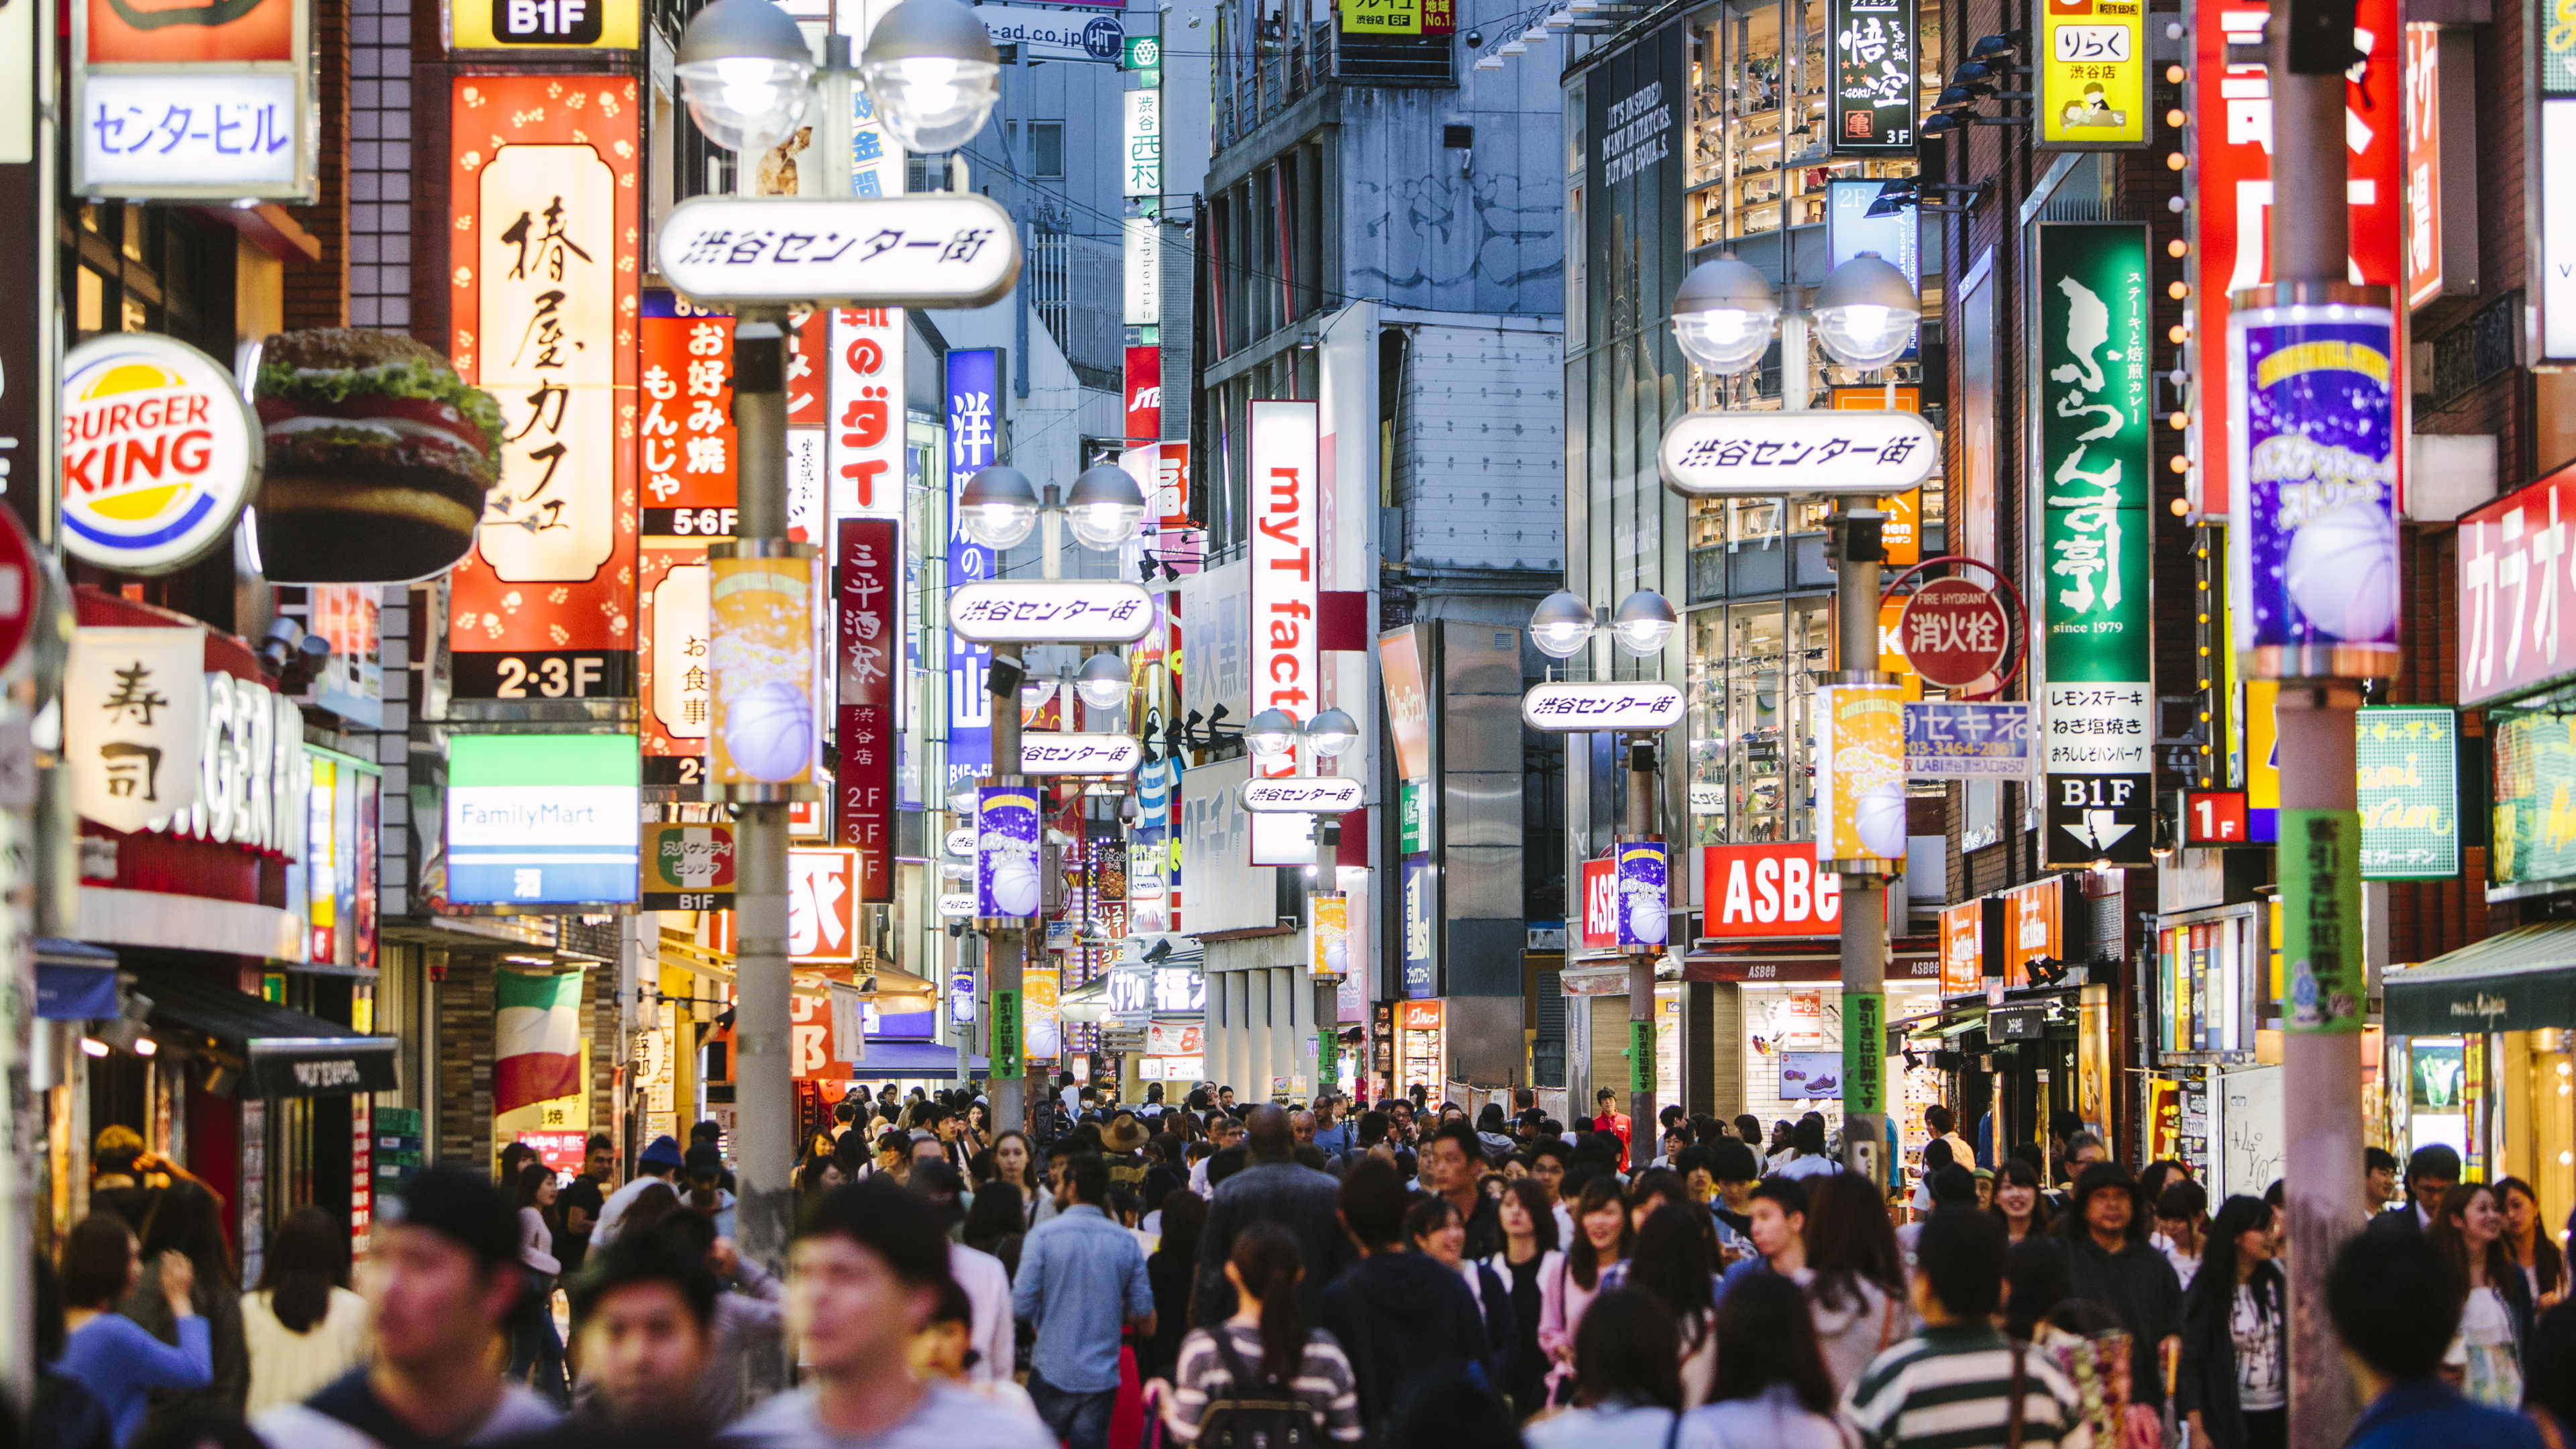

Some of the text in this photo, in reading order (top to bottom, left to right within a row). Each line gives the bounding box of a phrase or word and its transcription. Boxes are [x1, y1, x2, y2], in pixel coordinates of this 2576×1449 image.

[508, 0, 586, 34] B1F
[1356, 15, 1409, 25] 渋谷店 6F
[1426, 13, 1450, 27] No.1
[2065, 32, 2121, 58] りらく
[2070, 65, 2116, 79] 渋谷店
[1138, 96, 1154, 131] 渋谷
[93, 102, 290, 155] センタービル
[1886, 129, 1909, 144] 3F
[1603, 127, 1625, 161] MANY
[1605, 158, 1621, 187] BUT
[1621, 152, 1634, 179] NO
[1839, 188, 1868, 208] 2F
[679, 229, 996, 265] 渋谷センター街
[2125, 272, 2145, 426] ステーキと焙煎カレー
[686, 322, 727, 474] お好み焼
[642, 365, 680, 502] もんじゃ
[61, 429, 213, 500] KING
[1678, 436, 1923, 468] 渋谷センター街
[1917, 592, 1988, 605] FIRE HYDRANT
[2465, 483, 2576, 694] カラオ
[959, 599, 1142, 623] 渋谷センター街
[1910, 610, 1999, 653] 消火栓
[2053, 621, 2124, 634] since 1979
[1534, 696, 1676, 716] 渋谷センター街
[2052, 690, 2143, 706] レモンステーキ
[101, 660, 168, 802] 寿司
[854, 708, 875, 765] 渋谷店
[1920, 704, 2028, 741] セキネ
[2053, 718, 2142, 735] ねぎ塩焼き
[1022, 746, 1127, 762] 谷センター街
[1909, 742, 2017, 757] 03-3464-2061
[2052, 746, 2143, 762] おろししそハンバーグ
[847, 787, 880, 808] 2F
[1250, 788, 1356, 803] 渋谷センター街
[2061, 778, 2135, 806] B1F
[462, 802, 595, 830] FamilyMart
[2194, 800, 2235, 838] 1F
[847, 823, 880, 844] 3F
[513, 867, 543, 899] 酒
[1722, 858, 1840, 924] ASBe
[679, 894, 715, 910] B1F
[1588, 873, 1617, 935] ASB
[1748, 965, 1776, 979] ASBee
[1911, 961, 1941, 976] ASBee
[1410, 1007, 1439, 1025] グルメ
[1804, 998, 1820, 1013] 8%
[1326, 1032, 1336, 1083] 客引きは犯です
[1637, 1023, 1650, 1090] 客引きは犯罪です
